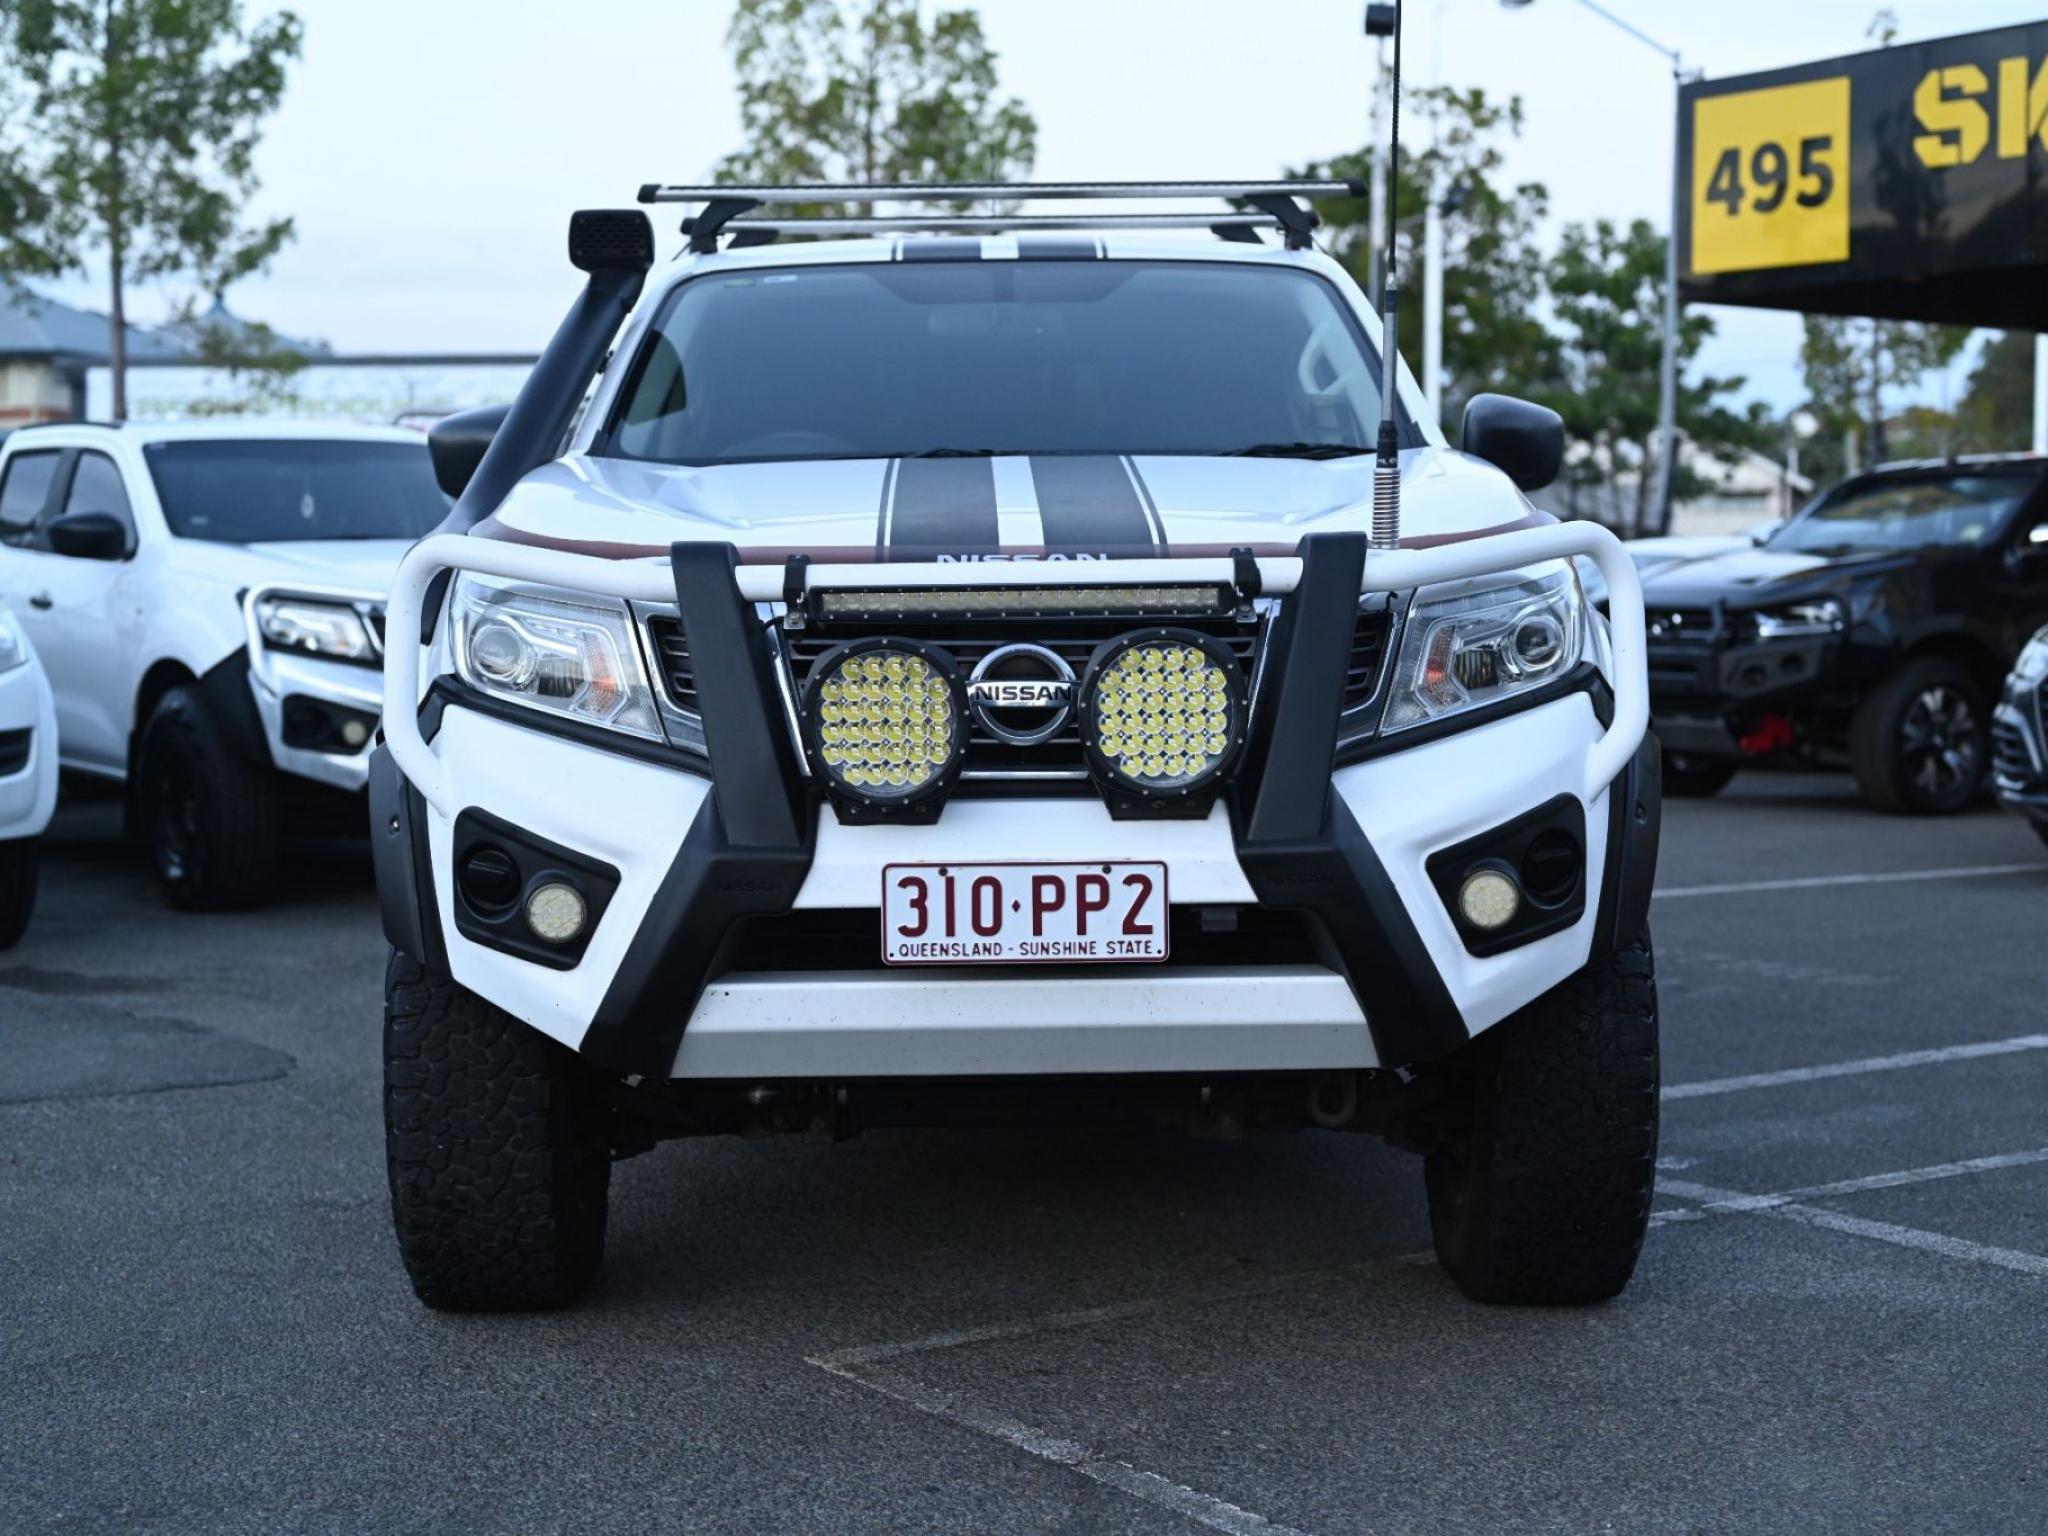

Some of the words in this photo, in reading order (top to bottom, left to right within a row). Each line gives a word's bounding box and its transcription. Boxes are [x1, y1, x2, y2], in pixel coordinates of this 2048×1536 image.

[1705, 134, 1835, 217] 495
[974, 685, 1072, 701] NISSAN
[898, 942, 1003, 957] QUEENSLAND
[1019, 941, 1097, 956] SUNSHINE
[1106, 939, 1153, 954] STATE
